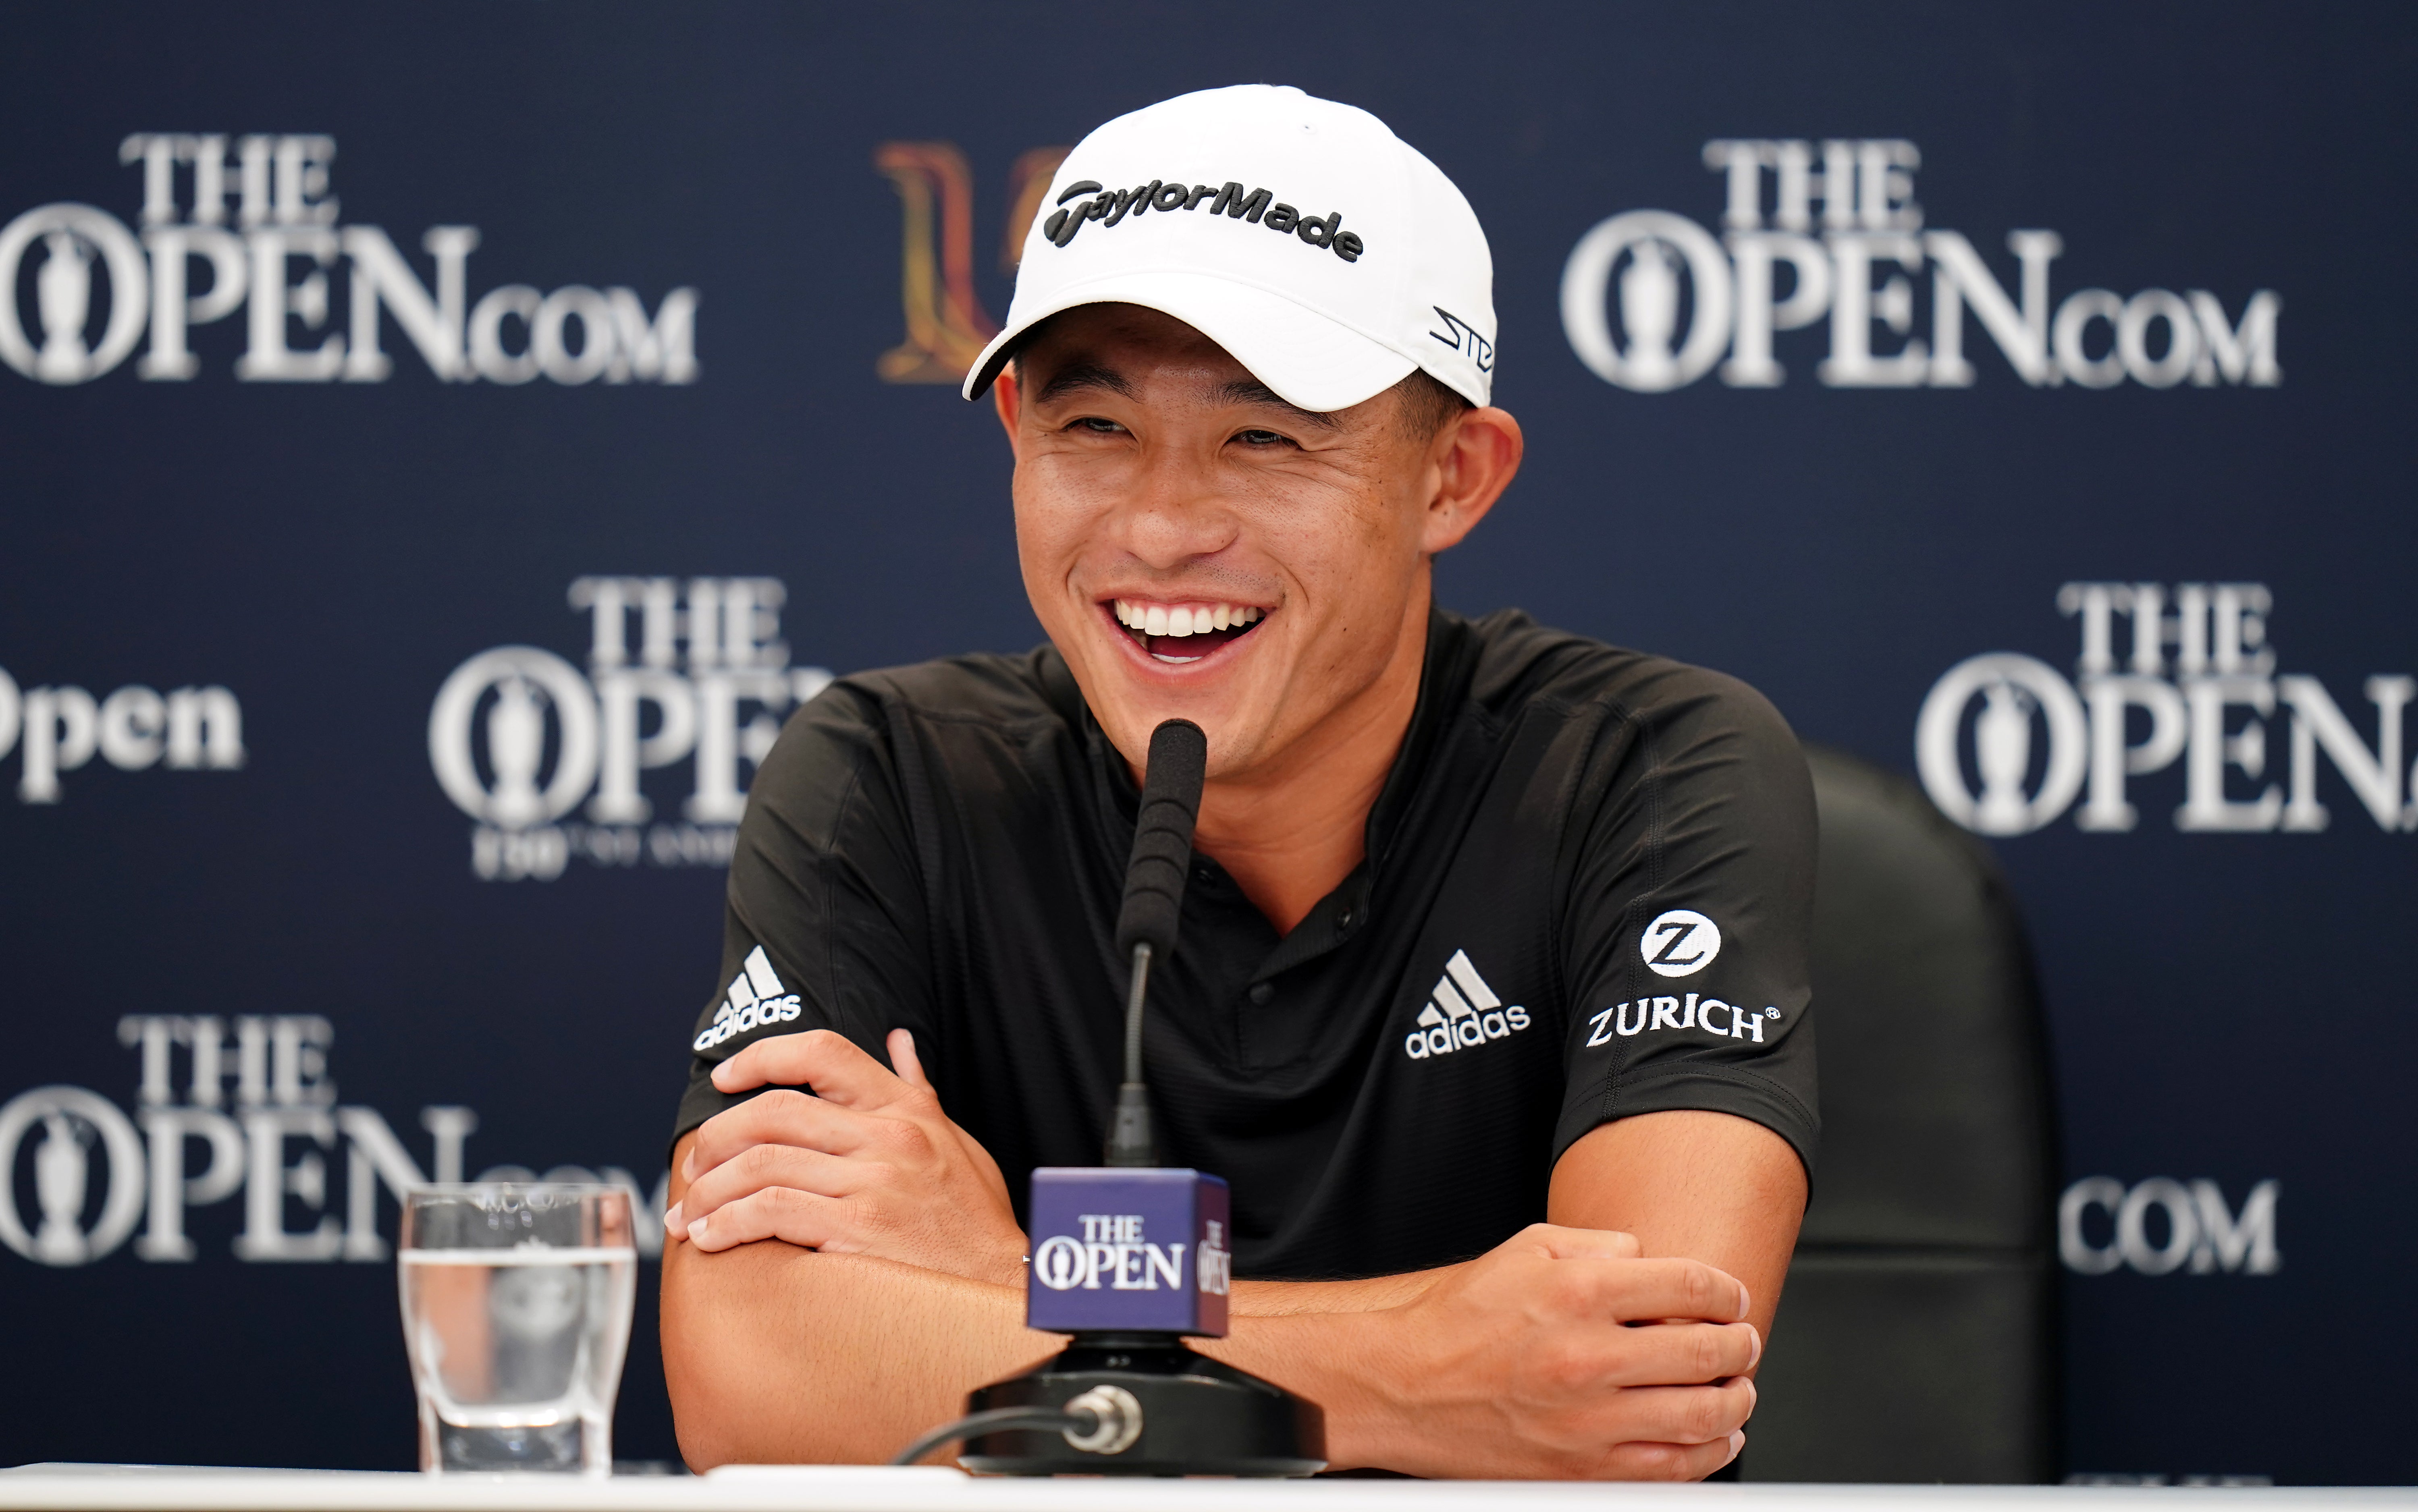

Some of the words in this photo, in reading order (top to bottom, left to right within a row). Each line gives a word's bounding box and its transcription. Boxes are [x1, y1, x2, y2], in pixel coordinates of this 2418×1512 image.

[120, 134, 338, 226] THE
[1044, 180, 1364, 263] TaylorMade
[1704, 140, 1922, 229] THE
[568, 577, 789, 670] THE
[2057, 584, 2275, 674] THE
[0, 668, 245, 802] pen
[429, 645, 834, 828] OPE
[1915, 652, 2418, 836] OPEN.
[119, 1016, 336, 1105] THE
[693, 994, 802, 1051] adidas
[1405, 1004, 1531, 1060] adidas
[1035, 1236, 1186, 1290] OPEN
[1078, 1214, 1145, 1243] THE
